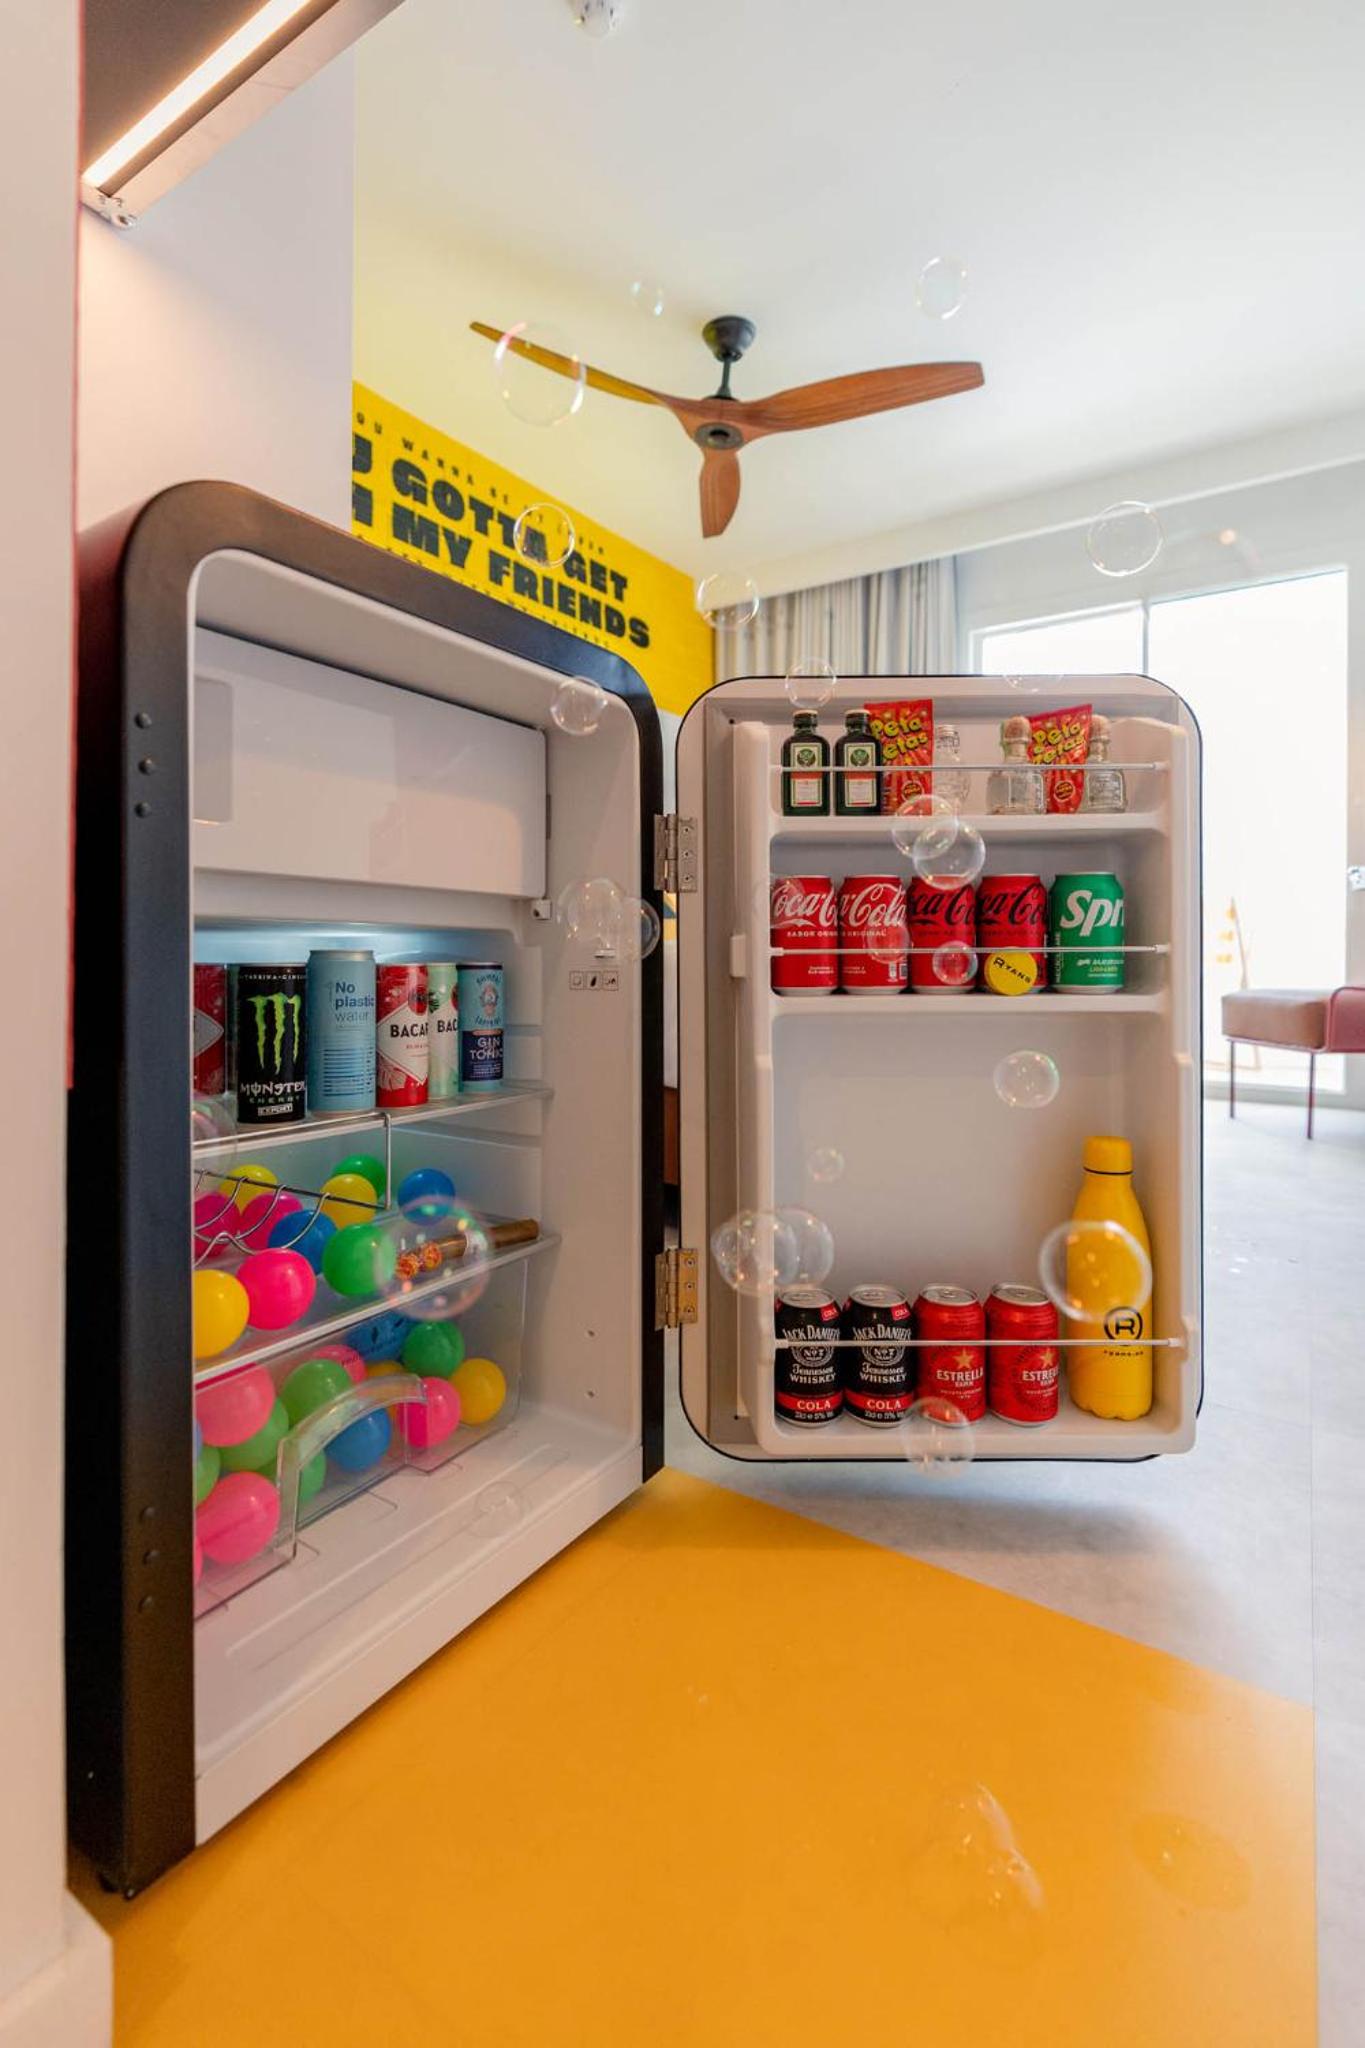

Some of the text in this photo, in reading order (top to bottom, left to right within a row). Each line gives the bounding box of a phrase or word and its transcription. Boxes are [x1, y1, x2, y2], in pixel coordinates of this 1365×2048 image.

[392, 458, 550, 568] GOTTA
[563, 548, 628, 602] GET
[392, 502, 471, 568] MY
[489, 549, 651, 649] FRIENDS
[883, 731, 929, 761] etas
[1060, 890, 1124, 937] Spr
[993, 957, 1032, 984] RYANS
[335, 982, 355, 994] No
[334, 1011, 369, 1022] water
[477, 1036, 501, 1048] GIN
[782, 1326, 806, 1340] JACK
[852, 1326, 875, 1340] JACK
[789, 1372, 836, 1385] WHISKEY
[860, 1371, 907, 1384] WHISKEY
[796, 1400, 831, 1411] COLA
[866, 1400, 902, 1410] COLA
